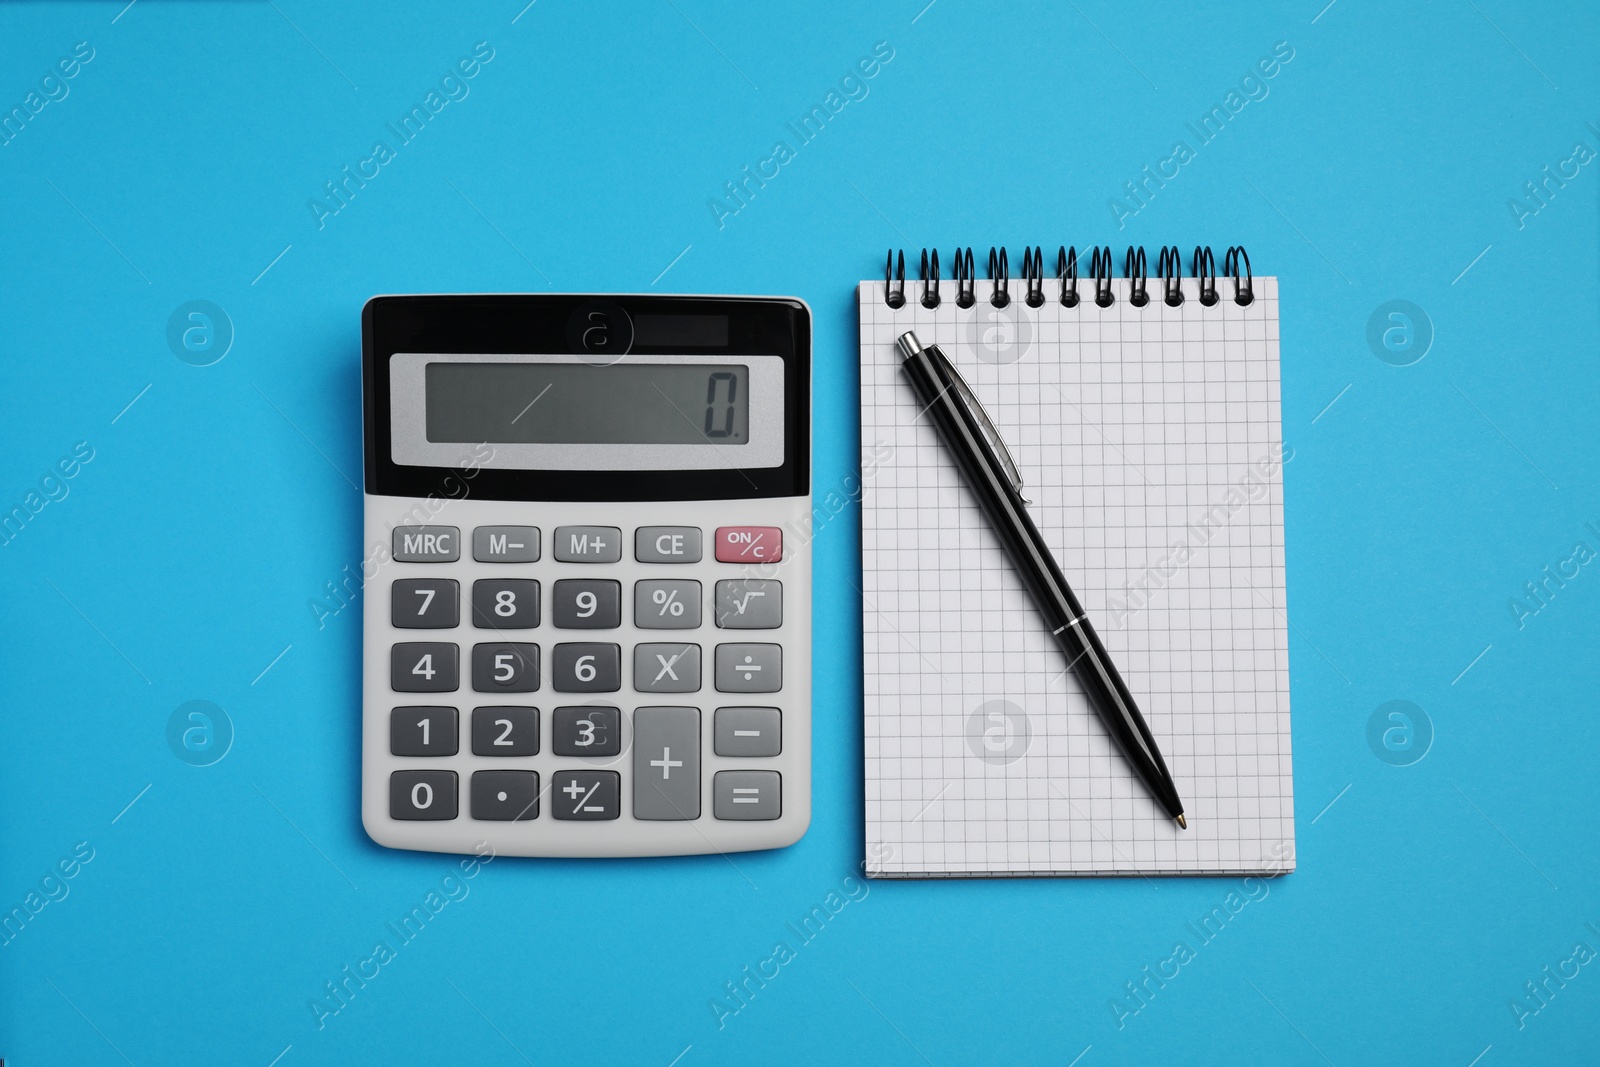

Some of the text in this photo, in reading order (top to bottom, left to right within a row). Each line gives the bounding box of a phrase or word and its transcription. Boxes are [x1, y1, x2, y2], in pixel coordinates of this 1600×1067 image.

[404, 534, 450, 554] MRC
[570, 534, 606, 554] M+
[655, 534, 684, 554] CE
[414, 589, 436, 616] 7
[494, 590, 517, 617] 8
[575, 591, 598, 618] 9
[652, 590, 685, 617] %
[412, 654, 436, 680] 4
[494, 654, 515, 681] 5
[574, 655, 597, 682] 6
[416, 718, 430, 745] 1
[493, 718, 514, 746] 2
[574, 719, 596, 747] 3
[411, 782, 434, 810] 0
